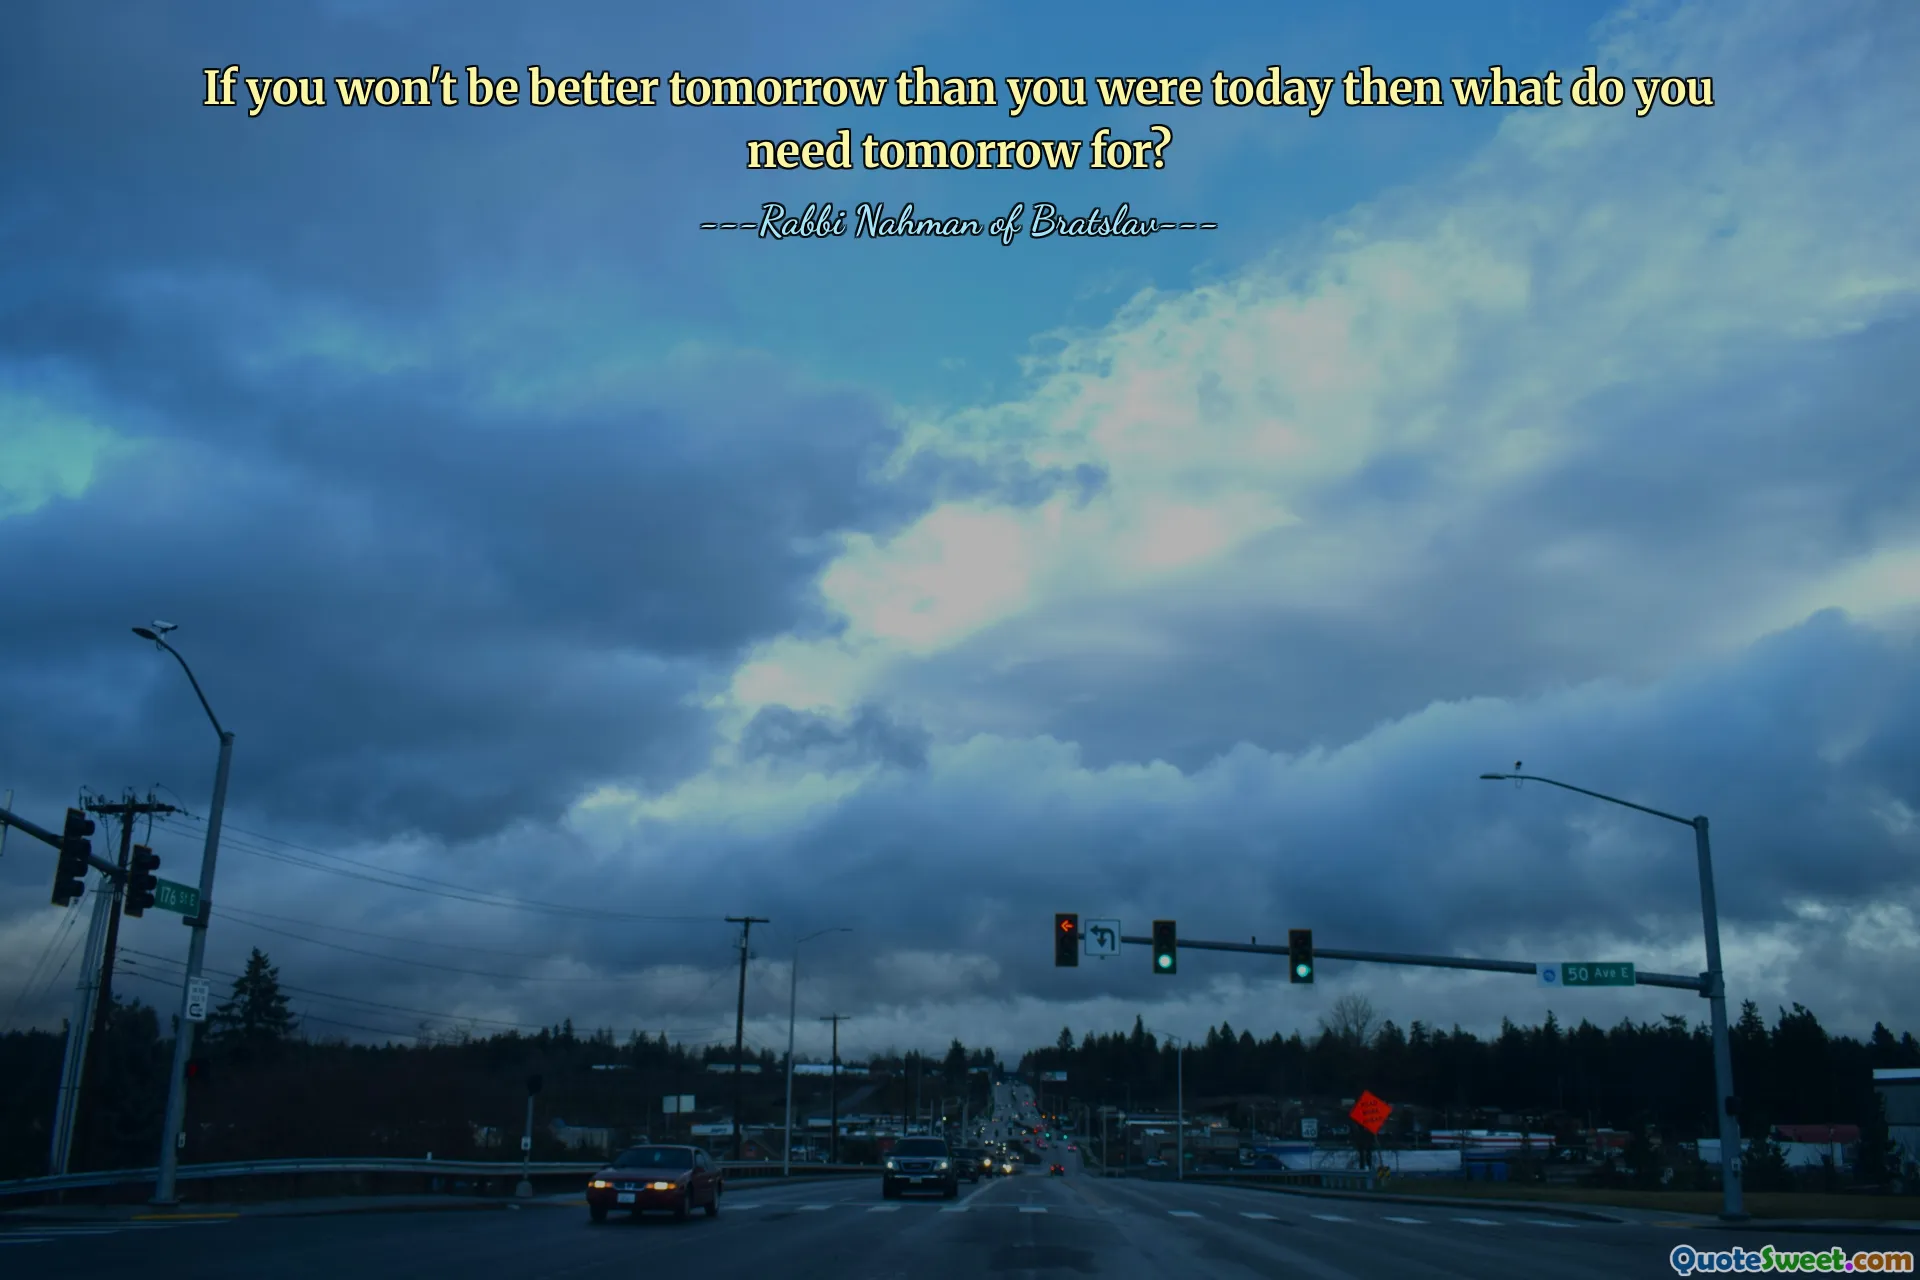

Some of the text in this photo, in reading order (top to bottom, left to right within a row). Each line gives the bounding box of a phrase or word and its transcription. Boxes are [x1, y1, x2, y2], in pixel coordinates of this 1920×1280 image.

[161, 886, 196, 907] 176 St E
[1568, 967, 1629, 982] 50 Ave E
